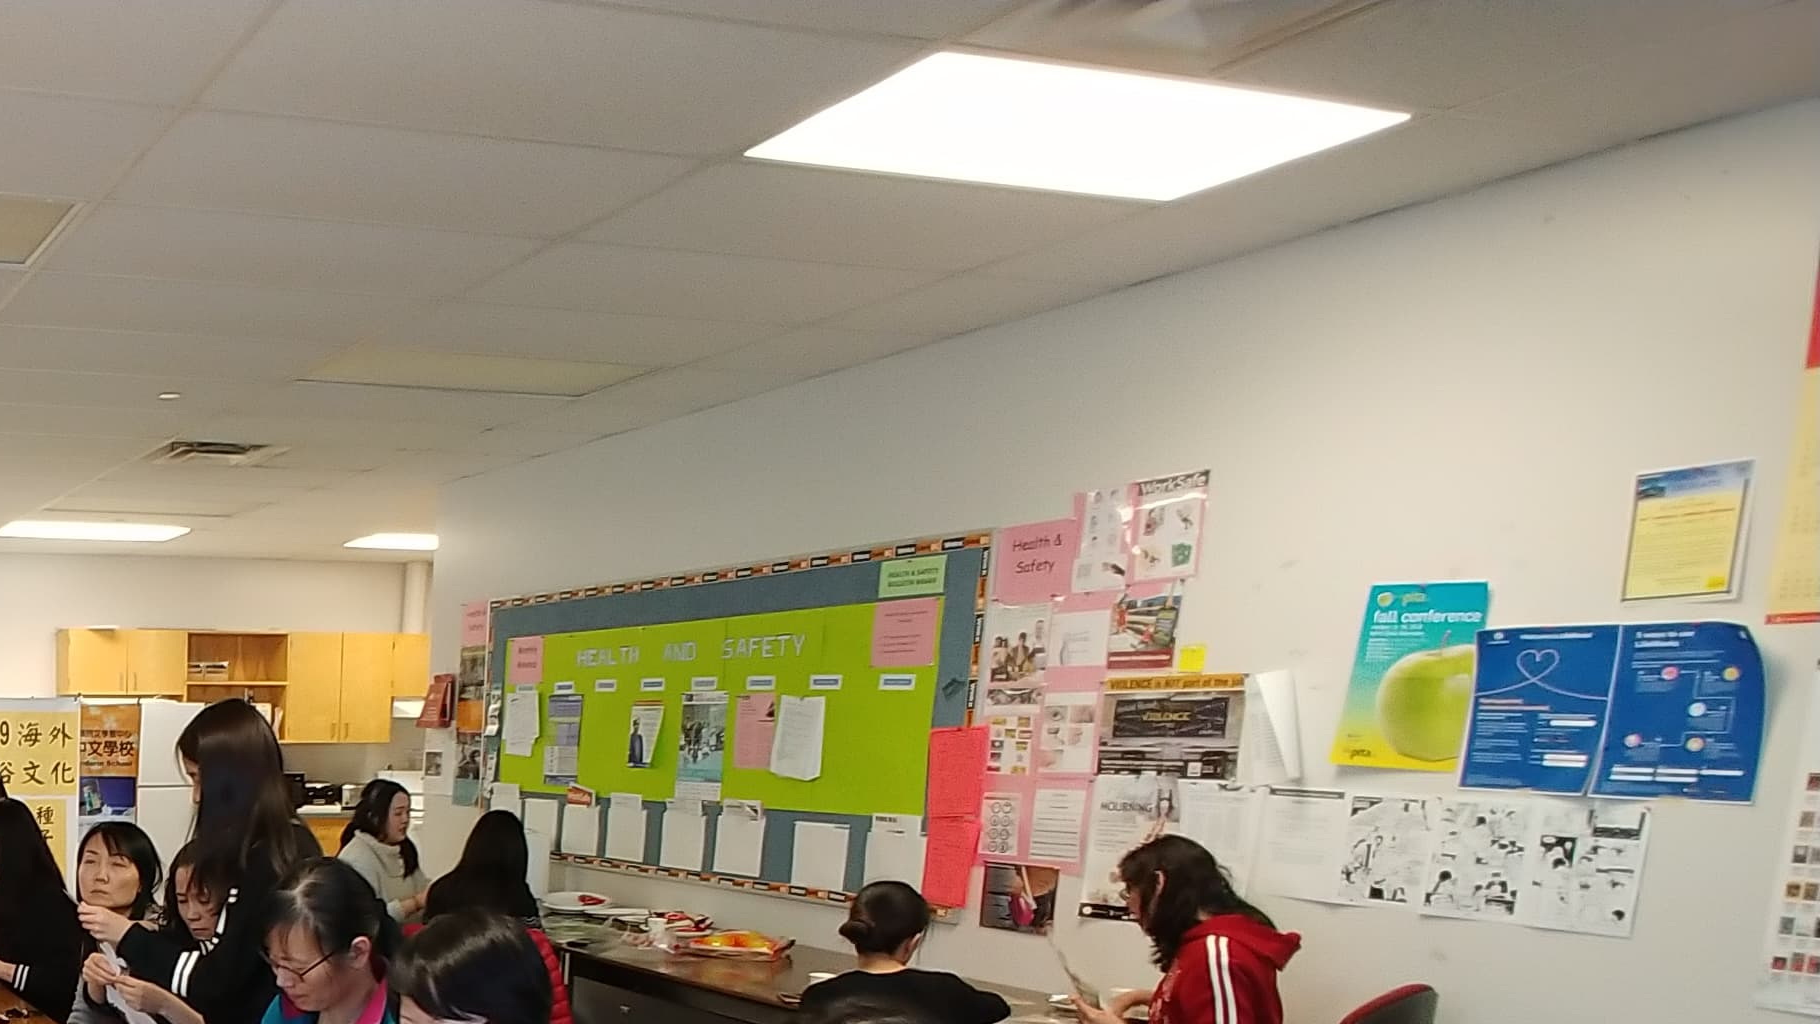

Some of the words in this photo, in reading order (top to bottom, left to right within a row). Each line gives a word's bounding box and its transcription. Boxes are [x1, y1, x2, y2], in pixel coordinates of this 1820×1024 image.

[1012, 537, 1051, 552] Health
[1015, 560, 1055, 574] Safety
[1373, 610, 1398, 623] fall
[1401, 609, 1482, 623] conference
[576, 646, 640, 668] HEALTH
[663, 641, 698, 662] AND
[721, 634, 805, 660] SAFETY
[17, 721, 73, 749] 海外
[1100, 801, 1153, 814] MOURNING
